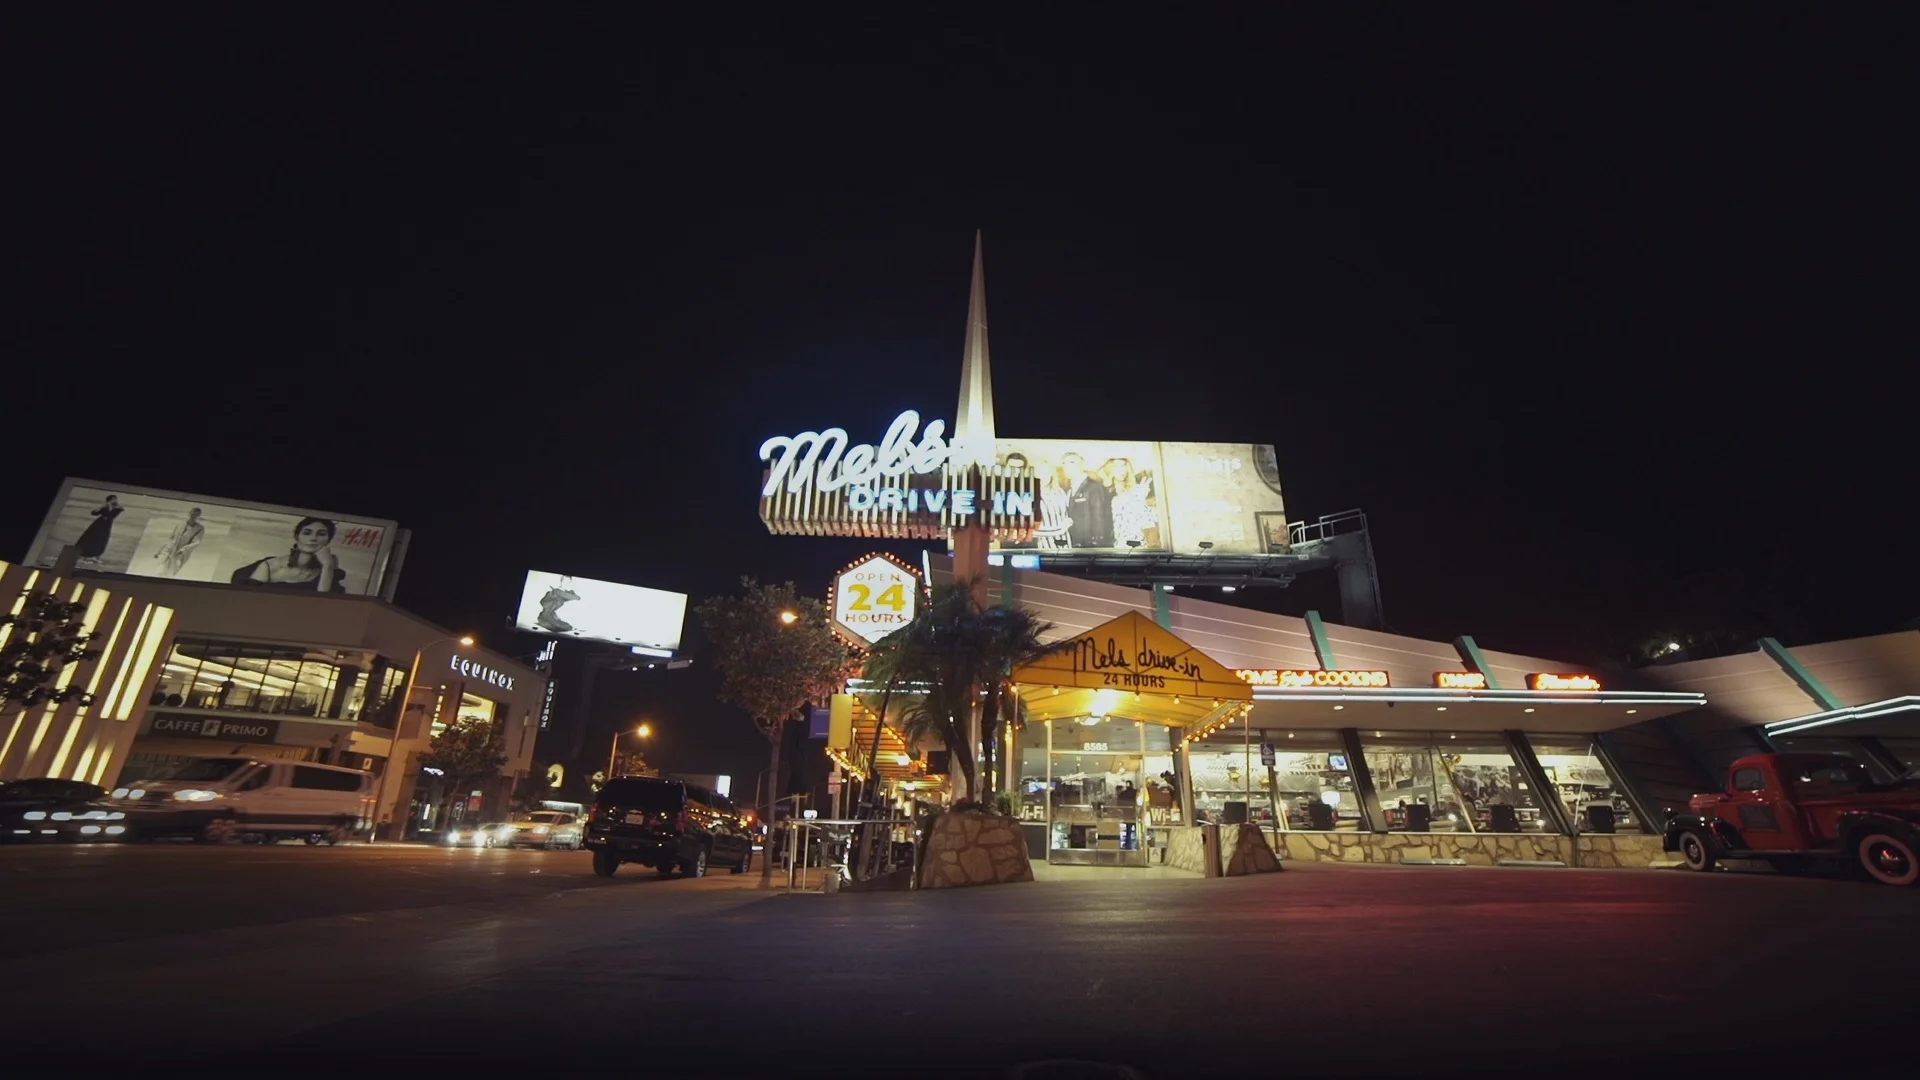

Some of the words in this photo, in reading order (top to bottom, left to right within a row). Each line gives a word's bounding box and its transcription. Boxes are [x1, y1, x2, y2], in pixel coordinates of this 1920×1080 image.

[759, 409, 953, 497] Mels
[849, 487, 976, 515] DRIVE
[993, 489, 1033, 516] IN
[855, 572, 902, 582] OPEN
[847, 583, 907, 612] 24
[845, 613, 906, 624] HOURS
[450, 654, 515, 691] EQUINOX
[1066, 637, 1130, 674] Mels
[1138, 637, 1204, 682] drive-in
[1104, 673, 1119, 686] 24
[1124, 675, 1165, 688] HOURS
[541, 681, 555, 728] EQUINOX
[154, 719, 201, 732] CAFFE
[222, 724, 268, 737] PRIMO
[1083, 742, 1108, 751] 8585
